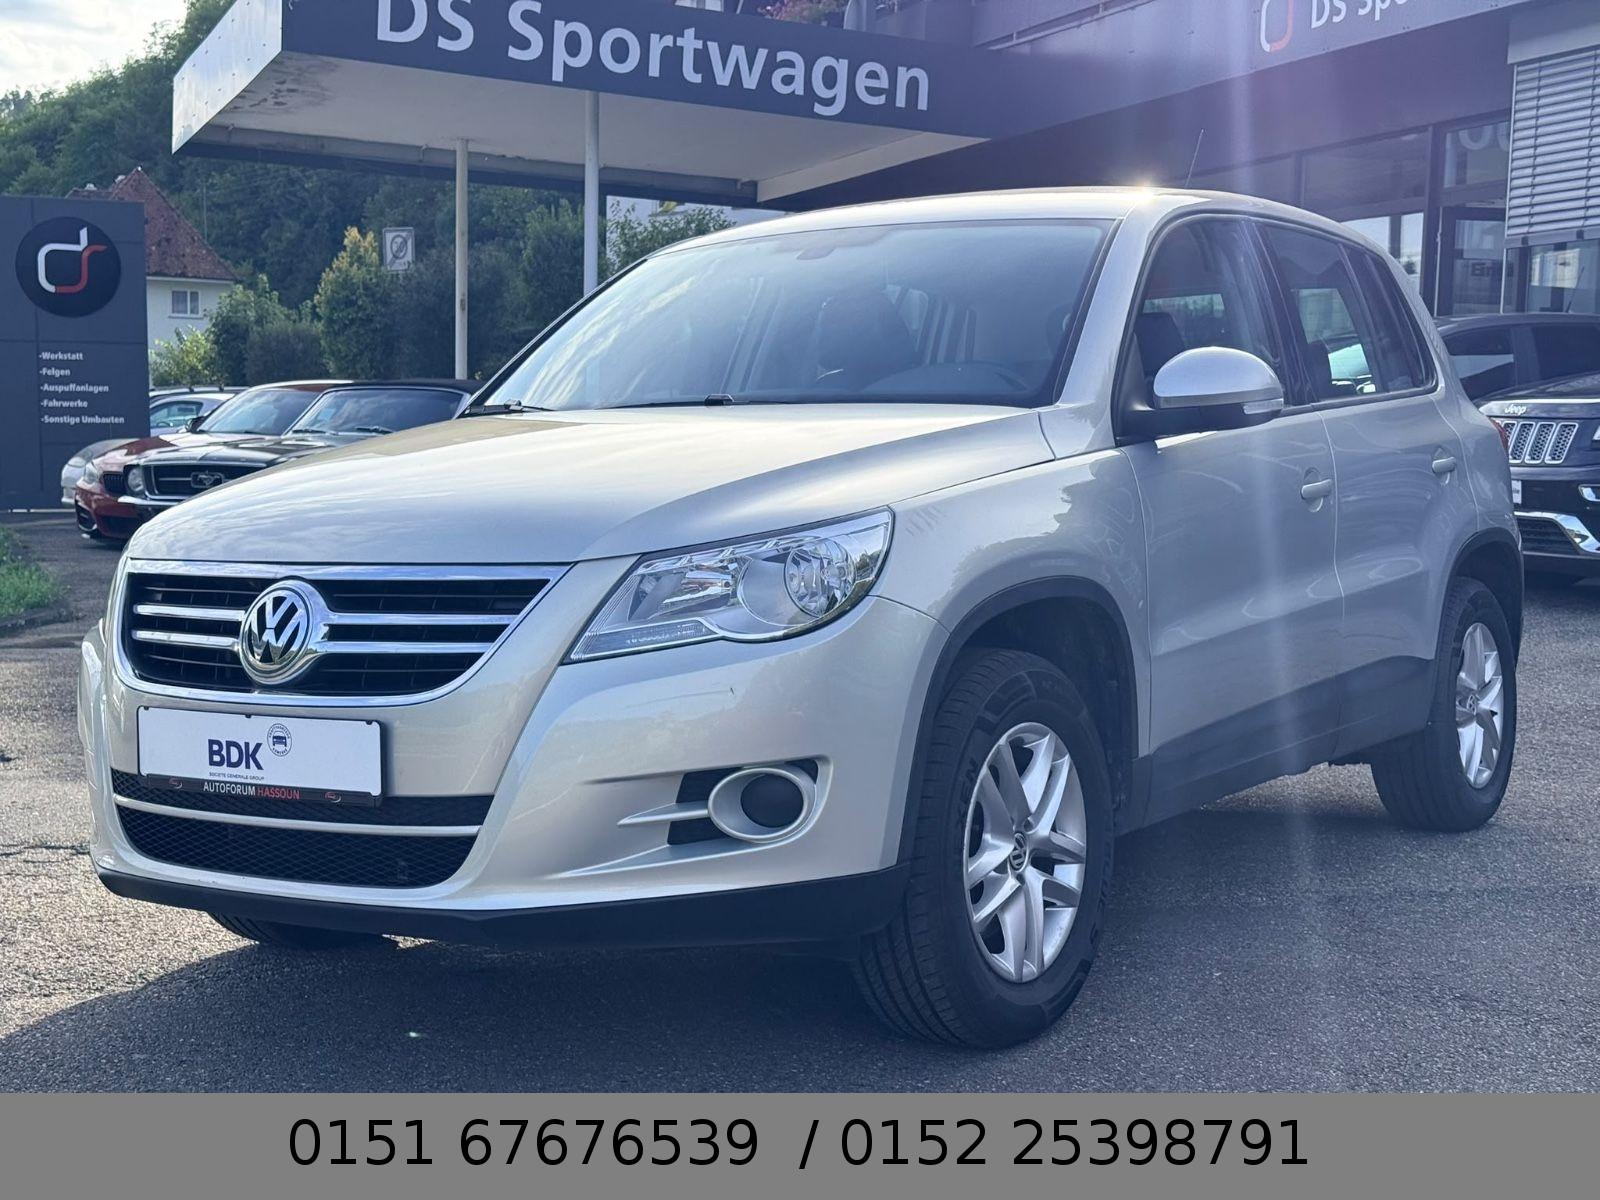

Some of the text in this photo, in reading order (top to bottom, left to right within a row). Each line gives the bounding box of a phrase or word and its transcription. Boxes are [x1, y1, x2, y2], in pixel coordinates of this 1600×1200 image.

[377, 0, 930, 116] DS Sportwagen
[1504, 403, 1527, 415] Jeep
[81, 415, 125, 424] Umbauten
[208, 739, 263, 770] BDK
[203, 781, 300, 800] AUTOFORUM HASSOUN
